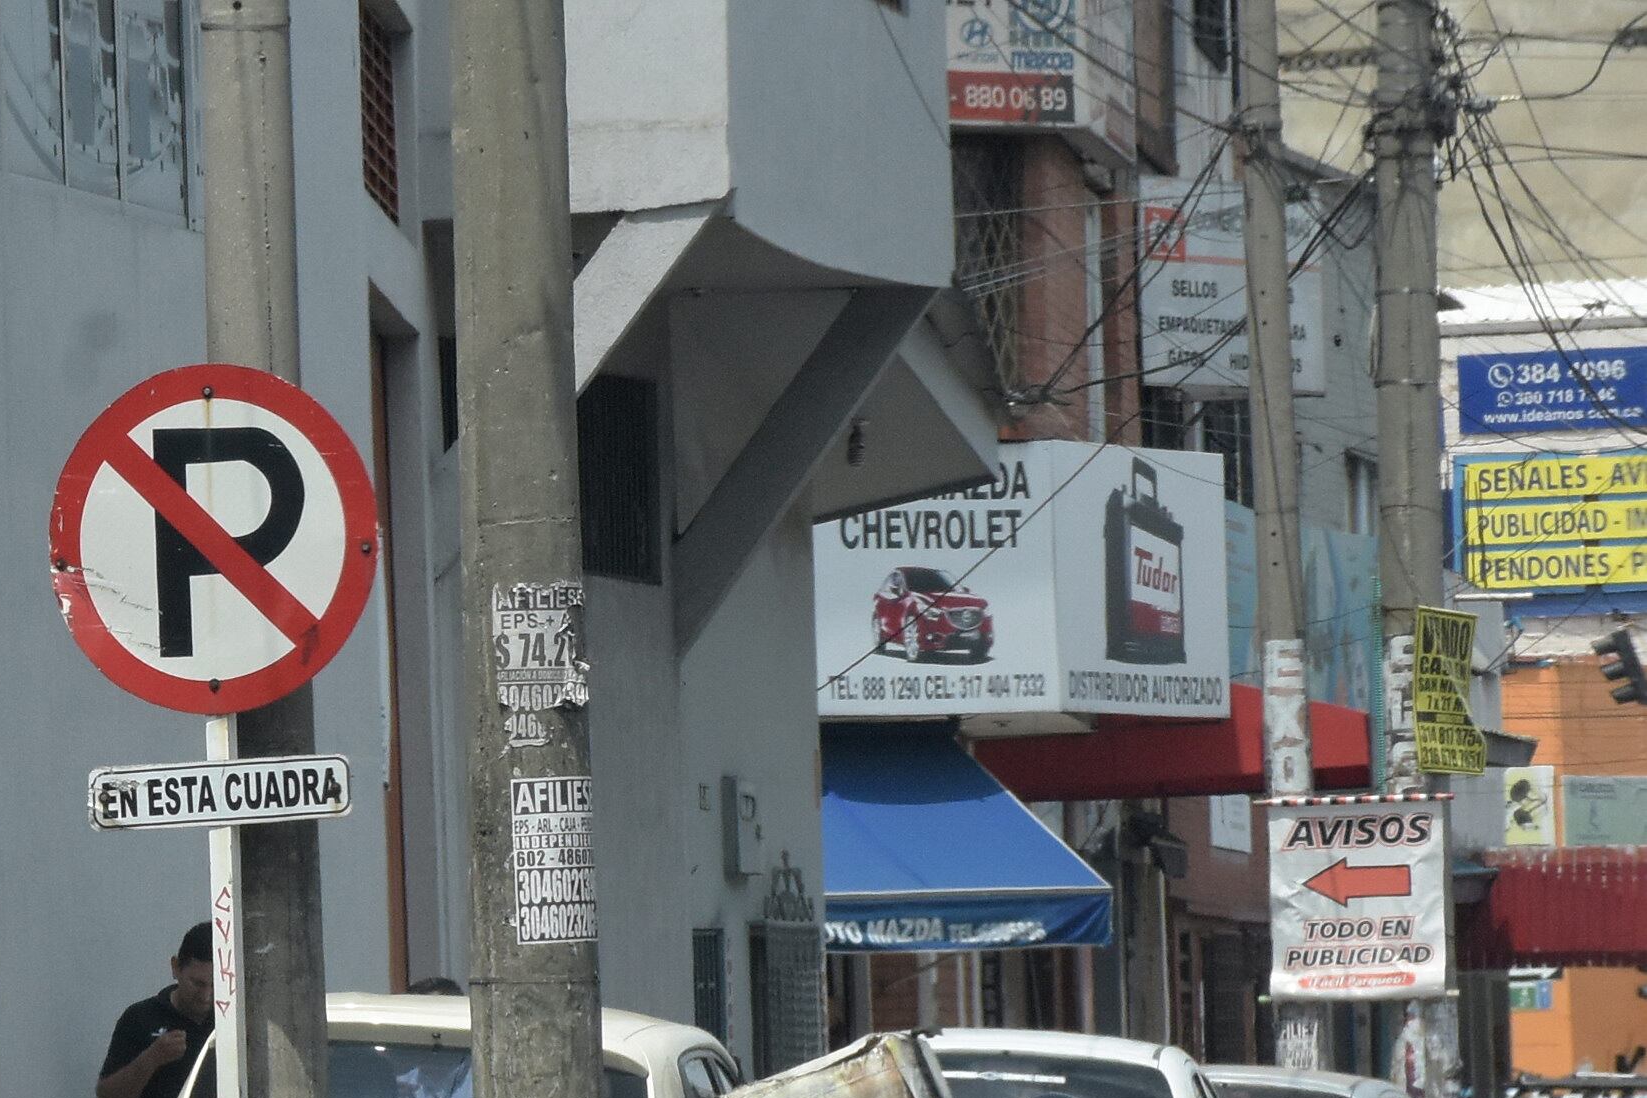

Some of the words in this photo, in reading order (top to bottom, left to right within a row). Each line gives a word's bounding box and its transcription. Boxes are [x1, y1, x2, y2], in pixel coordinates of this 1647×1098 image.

[964, 85, 1005, 108] 880
[1040, 86, 1068, 111] 89
[1171, 279, 1218, 298] SELLOS
[1516, 362, 1561, 384] 384
[840, 508, 1023, 549] CHEVROLET
[1478, 509, 1608, 538] PUBLICIDAD
[1134, 545, 1178, 594] Tudor
[1480, 553, 1610, 581] PENDONES
[862, 675, 886, 700] 888
[890, 675, 921, 700] 1290
[924, 674, 955, 700] CEL:
[959, 674, 982, 699] 317
[1152, 674, 1223, 706] AUTORIZADO
[102, 782, 139, 819] EN
[147, 775, 217, 817] ESTA
[224, 767, 342, 812] CUADRA
[1284, 813, 1432, 849] AVISOS
[516, 850, 546, 868] 602
[866, 917, 943, 944] MAZDA
[1306, 919, 1373, 941] TODO
[1380, 917, 1413, 939] EN
[1286, 945, 1432, 968] PUBLICIDAD
